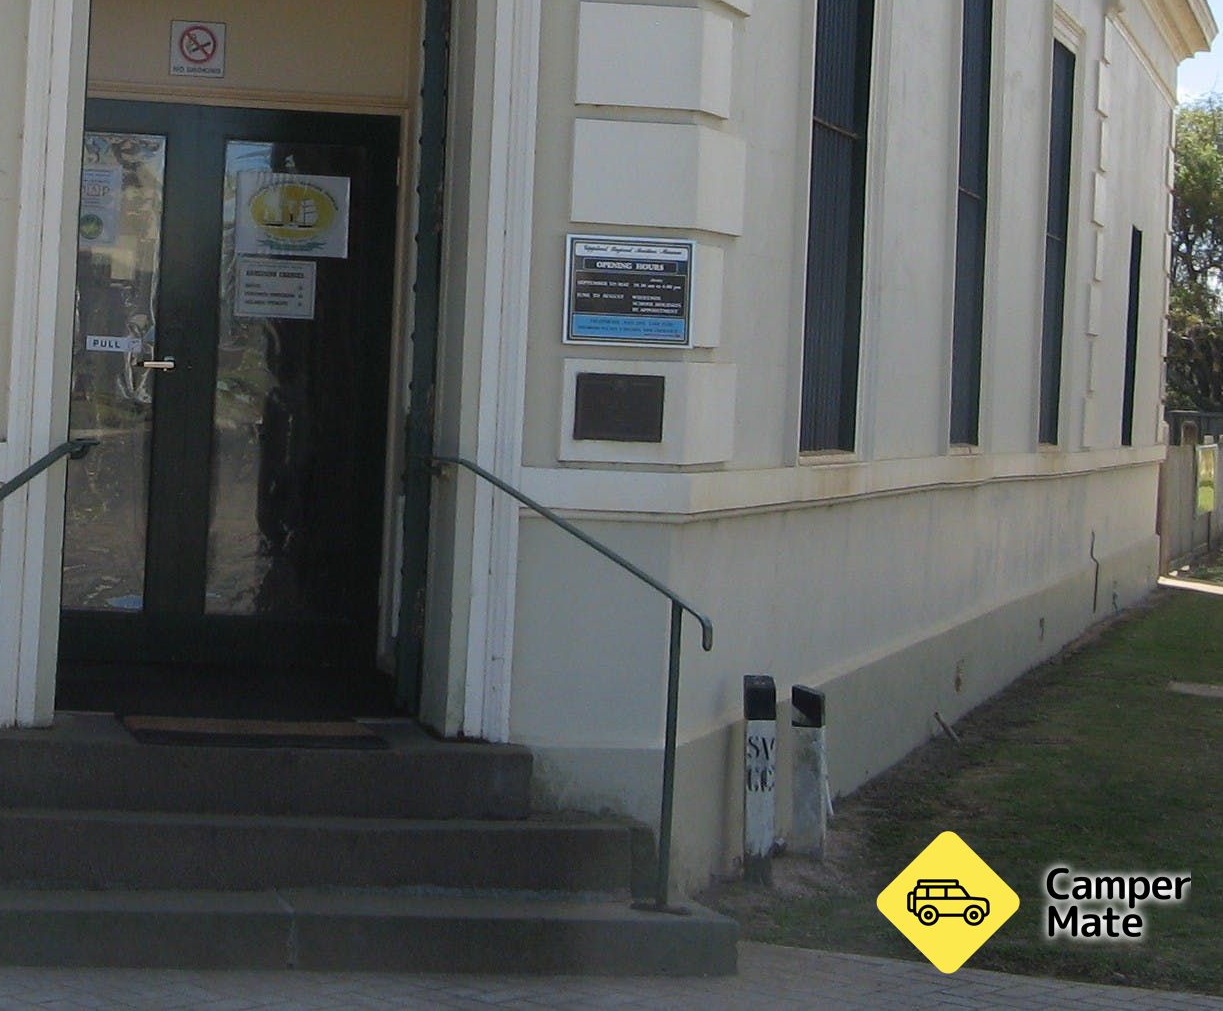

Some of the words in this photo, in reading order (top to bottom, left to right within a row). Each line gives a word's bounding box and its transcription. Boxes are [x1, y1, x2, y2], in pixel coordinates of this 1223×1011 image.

[596, 260, 633, 270] OPENING
[636, 262, 665, 271] HOURS
[93, 339, 121, 349] PULL
